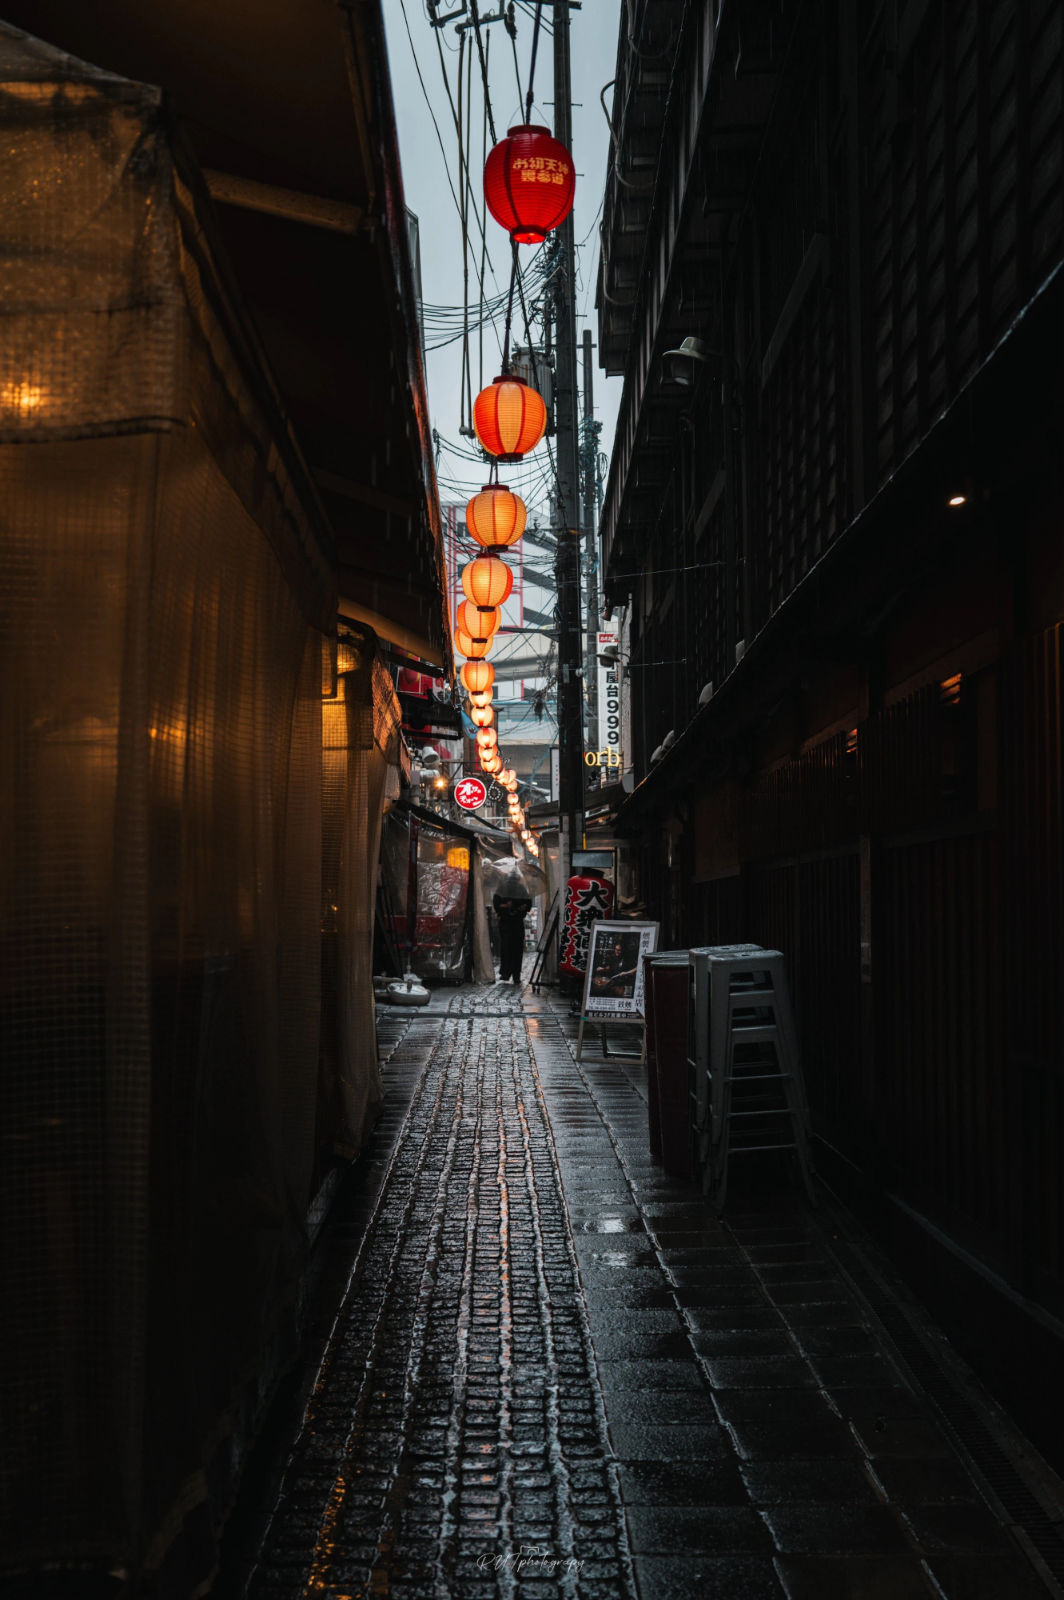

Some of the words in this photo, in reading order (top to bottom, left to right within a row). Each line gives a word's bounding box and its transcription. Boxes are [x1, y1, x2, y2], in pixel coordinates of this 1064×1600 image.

[512, 157, 569, 175] お初天神
[585, 746, 620, 767] orb
